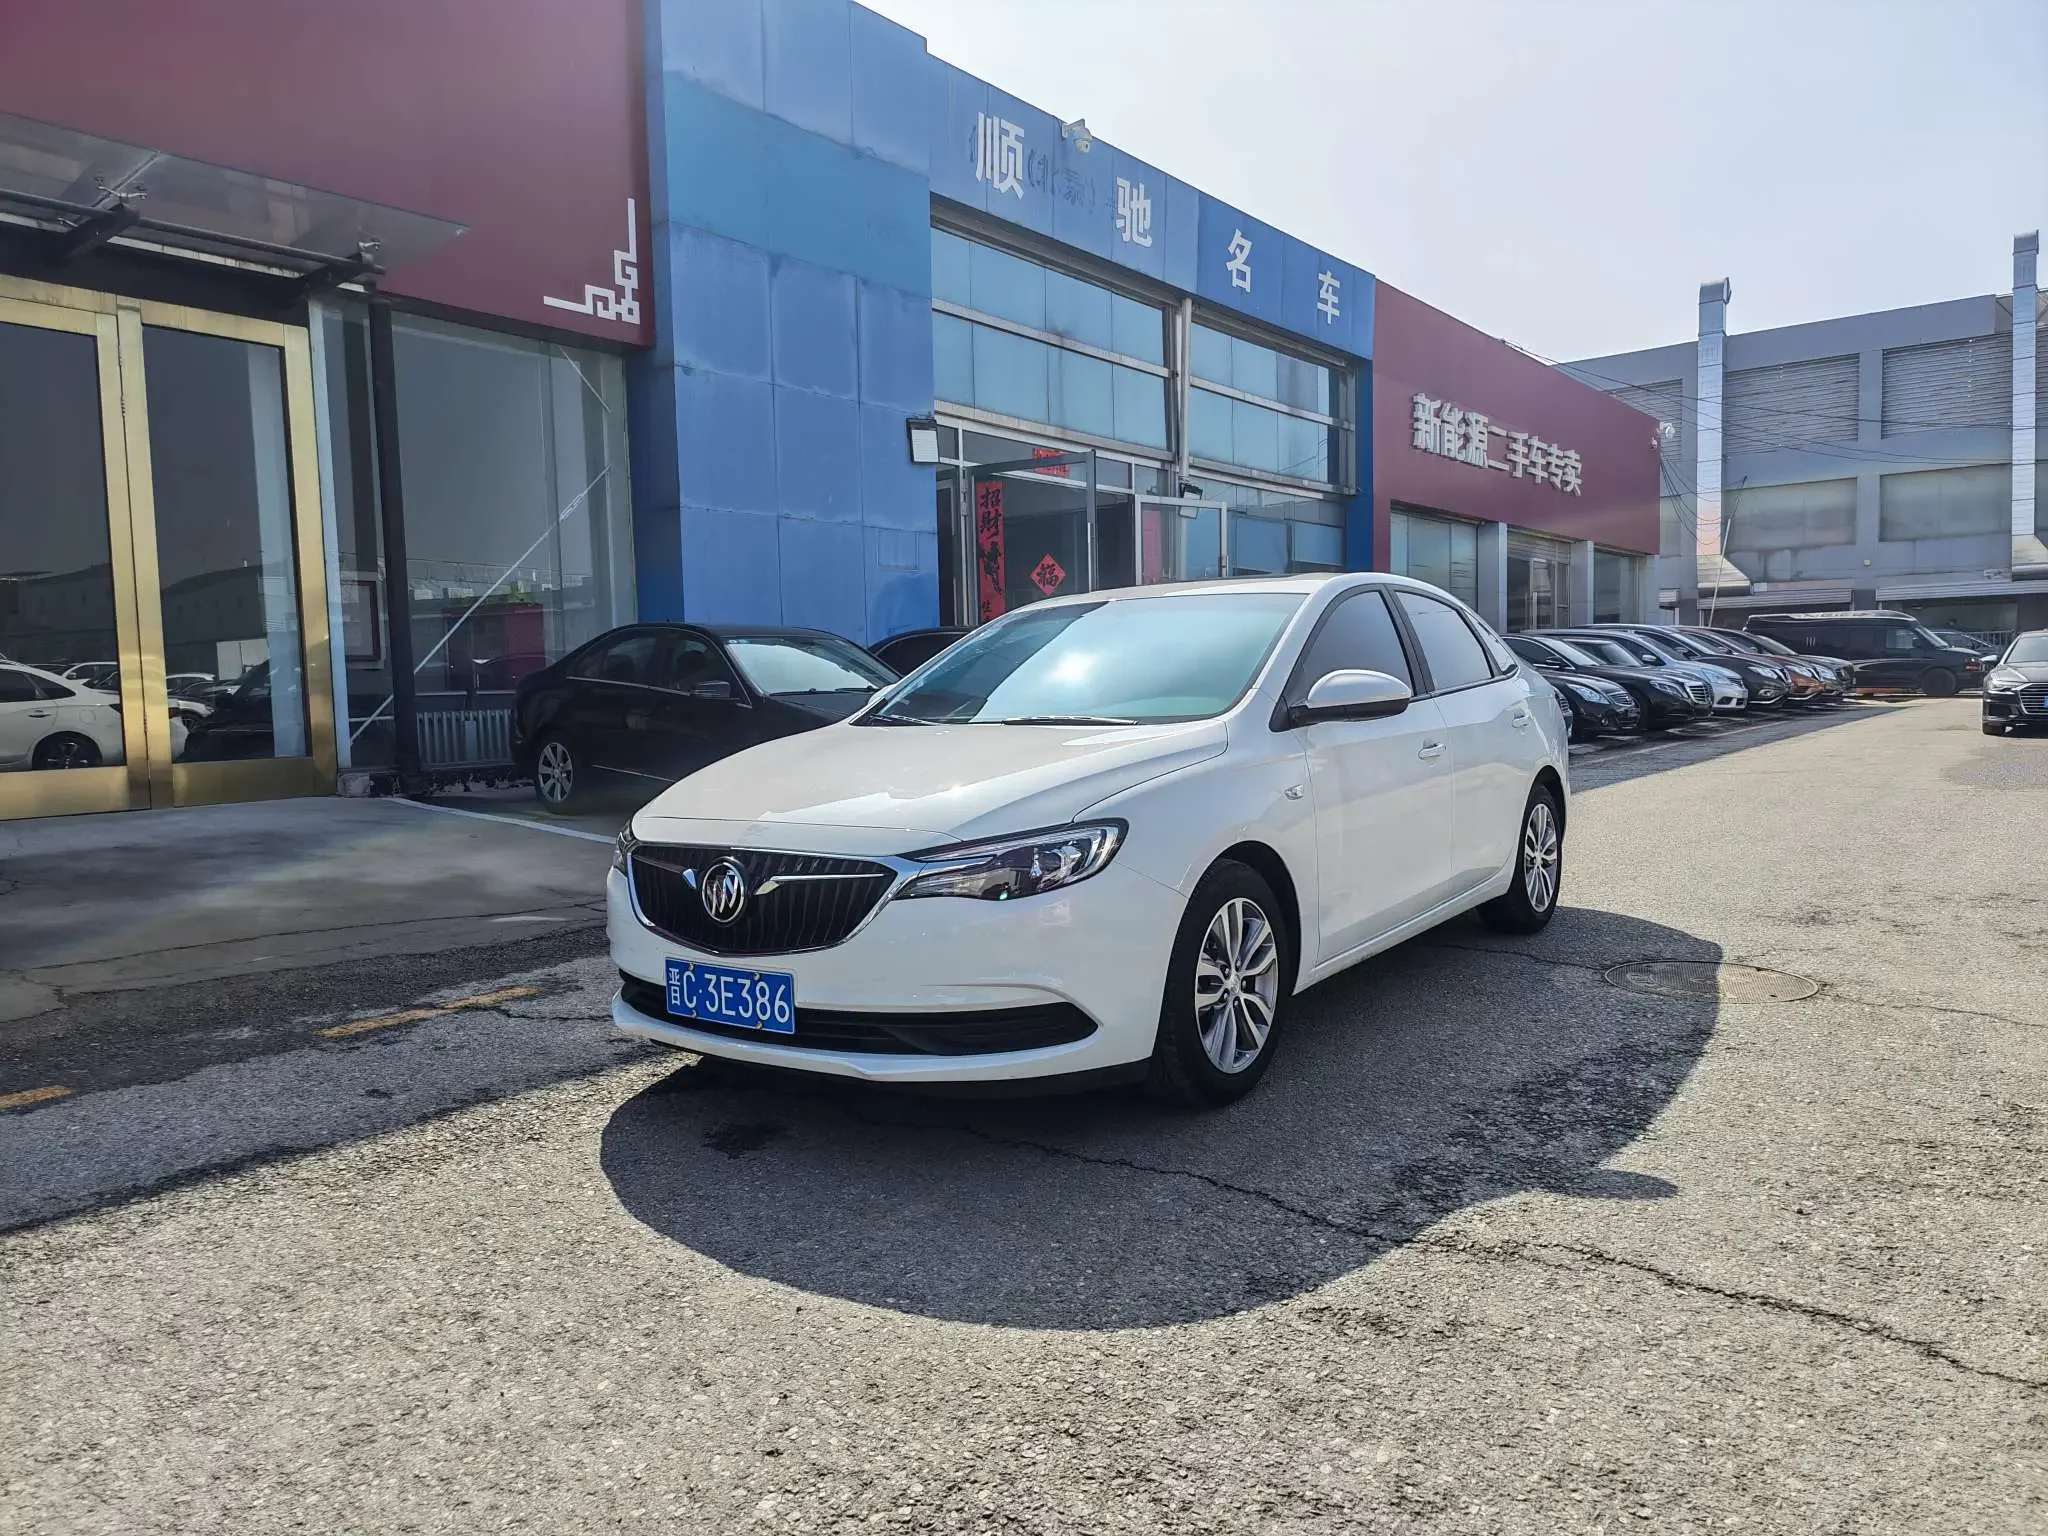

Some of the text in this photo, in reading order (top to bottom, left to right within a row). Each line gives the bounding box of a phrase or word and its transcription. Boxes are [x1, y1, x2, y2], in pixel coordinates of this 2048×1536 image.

[976, 111, 1341, 325] 顺驰名车
[1412, 392, 1582, 496] 新能源二手车专卖
[1037, 563, 1060, 588] 福
